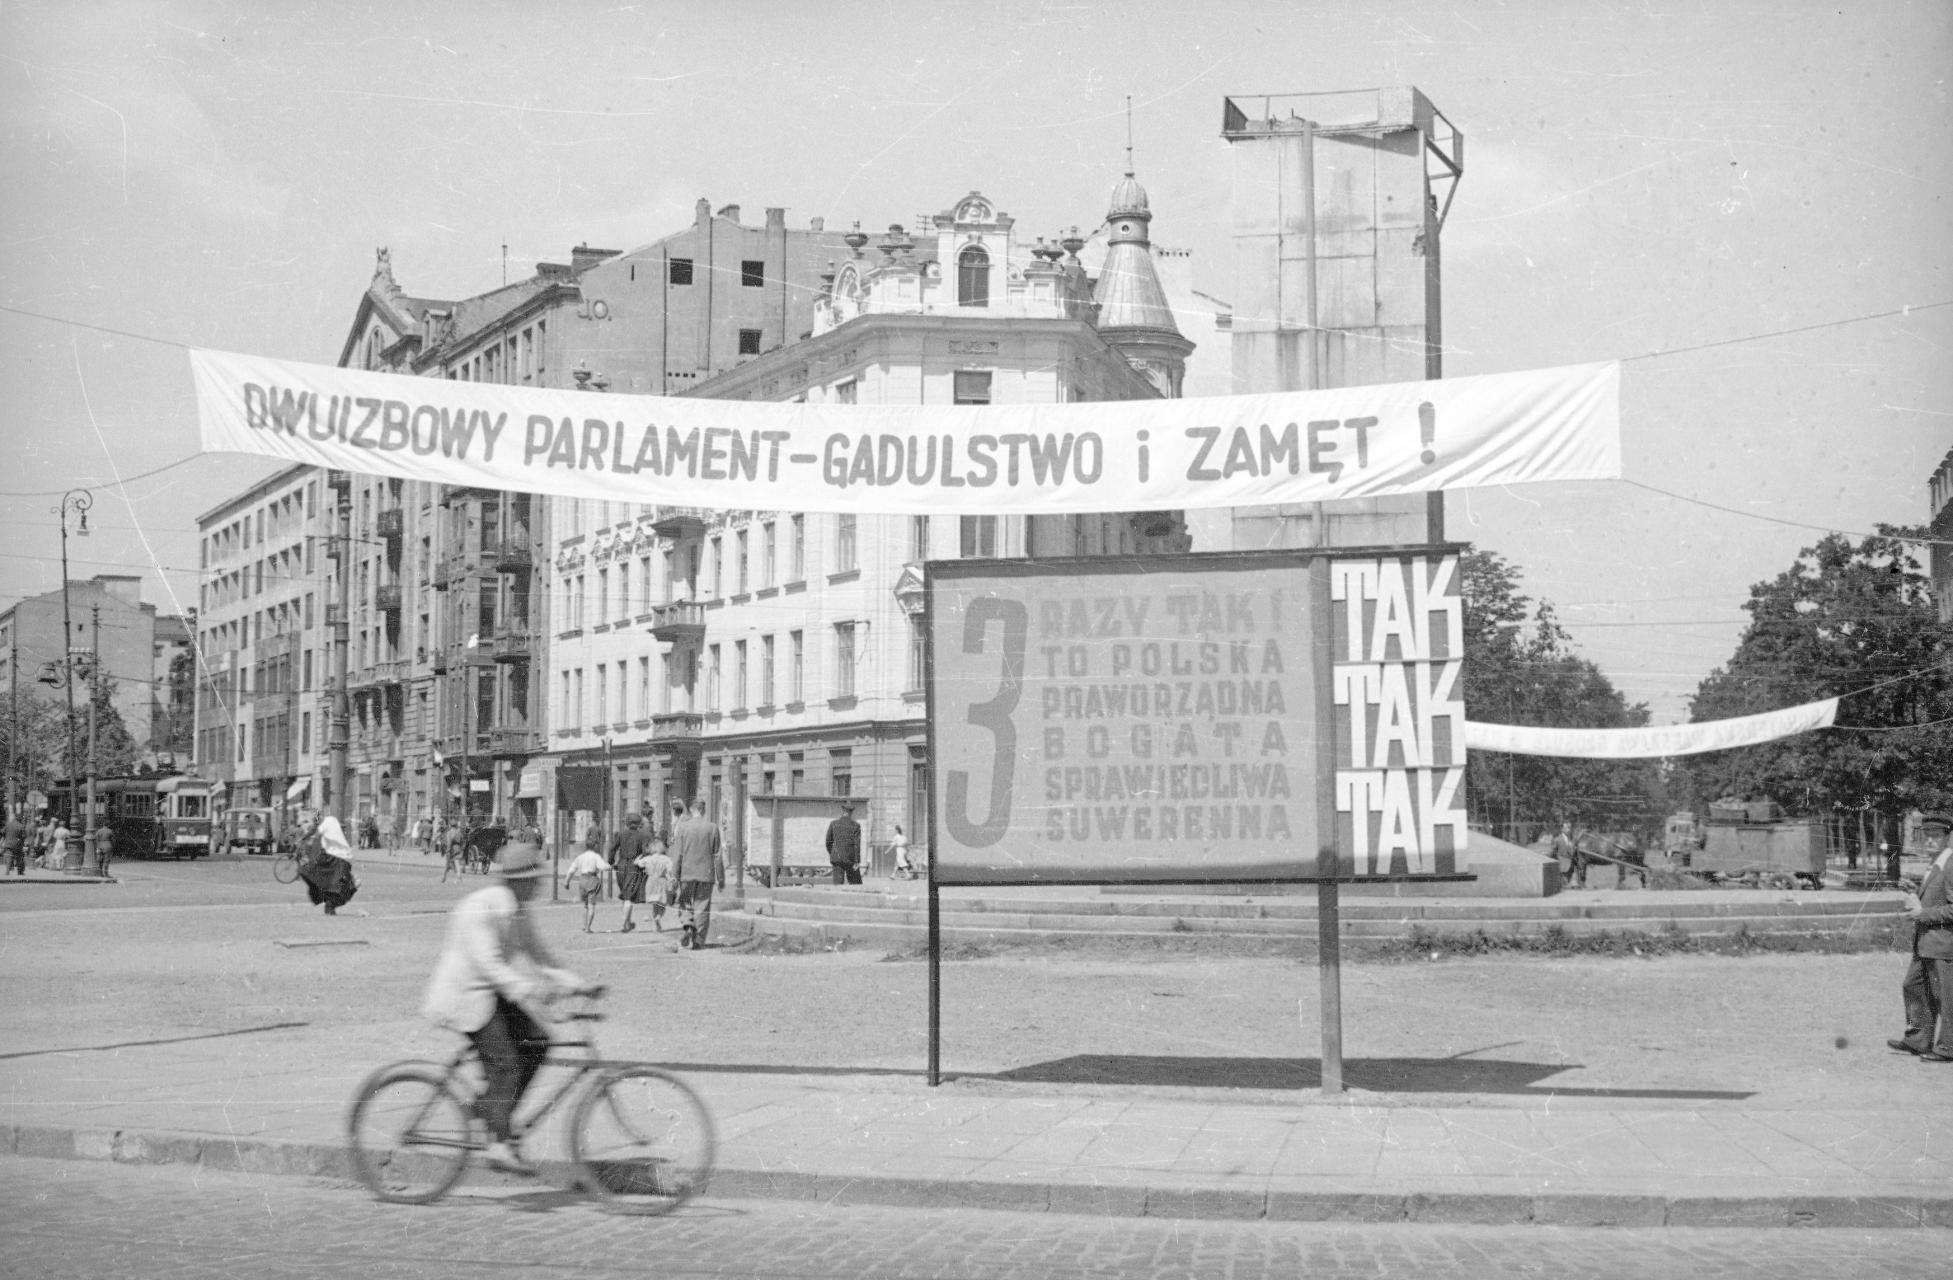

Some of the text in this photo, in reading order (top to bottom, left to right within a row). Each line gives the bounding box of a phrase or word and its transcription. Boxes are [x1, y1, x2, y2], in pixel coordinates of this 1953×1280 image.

[243, 381, 508, 463] DWUIZBOWY
[1136, 429, 1150, 484] i
[1184, 416, 1379, 484] ZAMĘT
[1040, 596, 1151, 638] RAZY
[1166, 591, 1256, 634] TAK
[1331, 555, 1464, 662] TAK
[1041, 638, 1285, 677] TO POLSKA
[945, 597, 1028, 848] 3
[1042, 679, 1286, 721] PRAWORZĄDNA
[1333, 660, 1467, 768] TAK
[1044, 721, 1288, 760] BOGATA
[1045, 763, 1291, 801] SPRAWIEDLIWA
[1047, 804, 1292, 841] SUWERENNA
[1336, 768, 1469, 876] TAK
